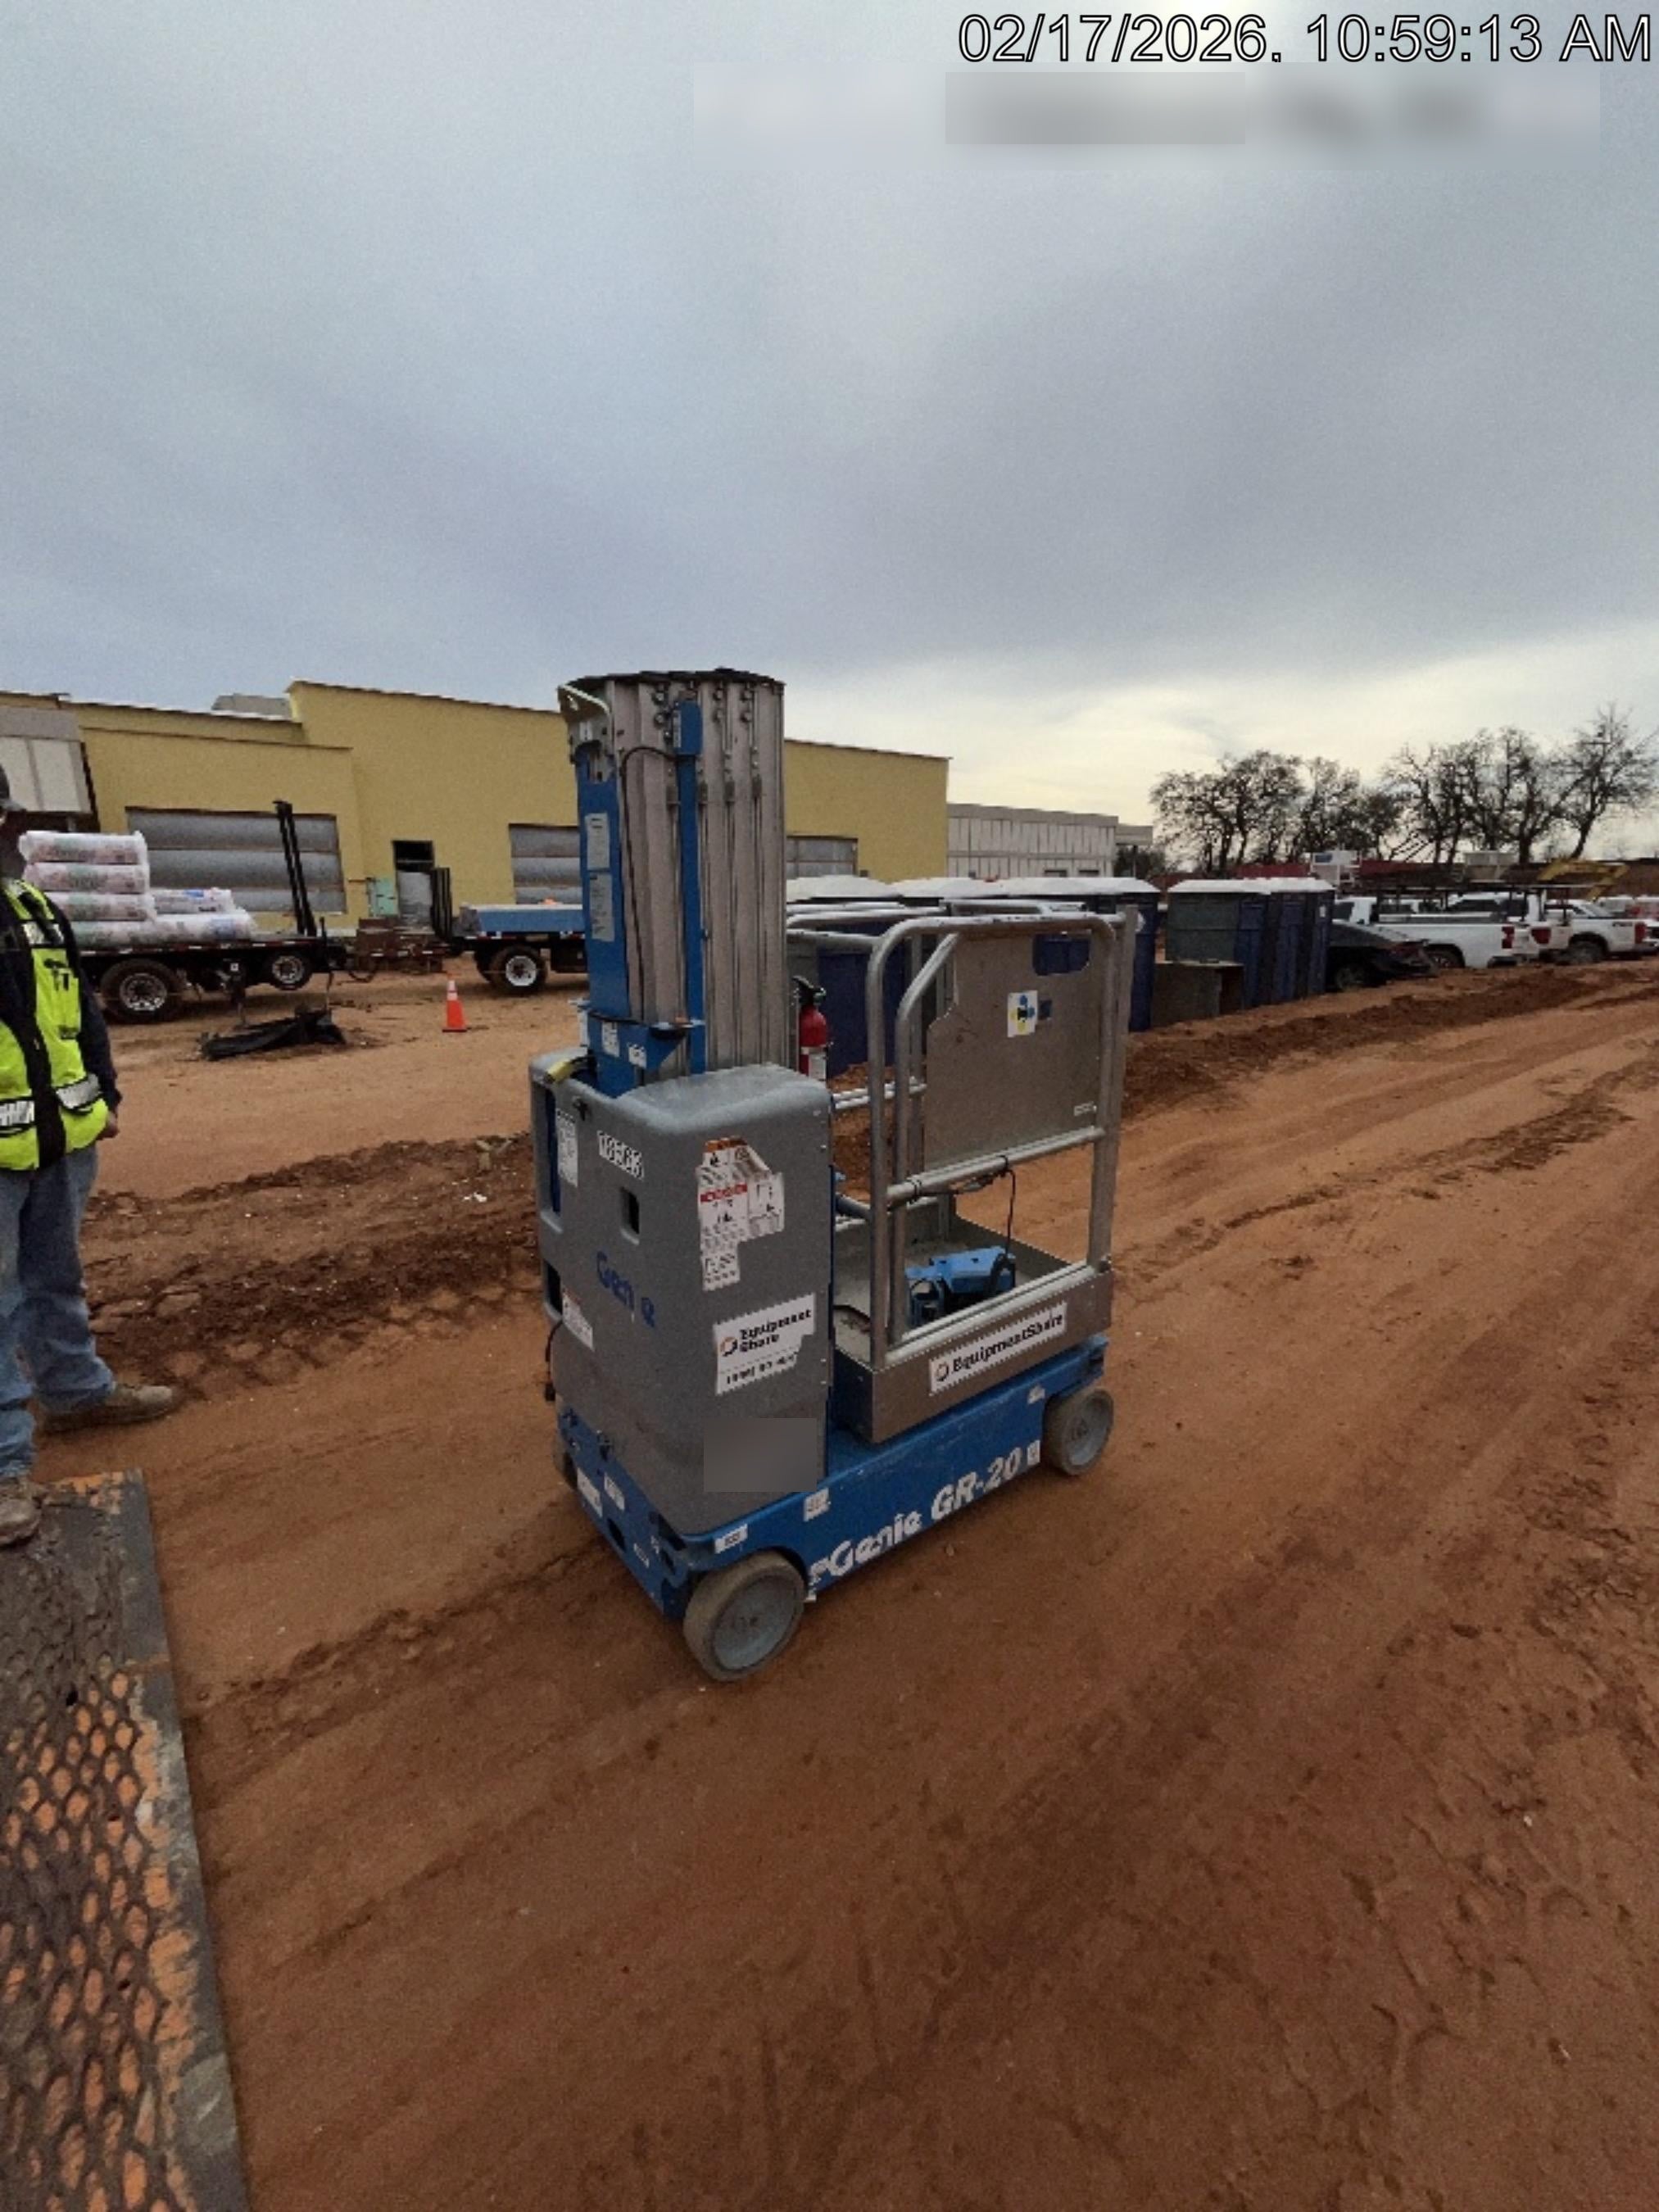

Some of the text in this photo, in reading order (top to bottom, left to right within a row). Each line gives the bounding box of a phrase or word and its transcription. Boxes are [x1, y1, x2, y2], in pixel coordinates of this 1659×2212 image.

[739, 1334, 779, 1353] Share
[826, 1446, 1022, 1578] Genie GR-20
